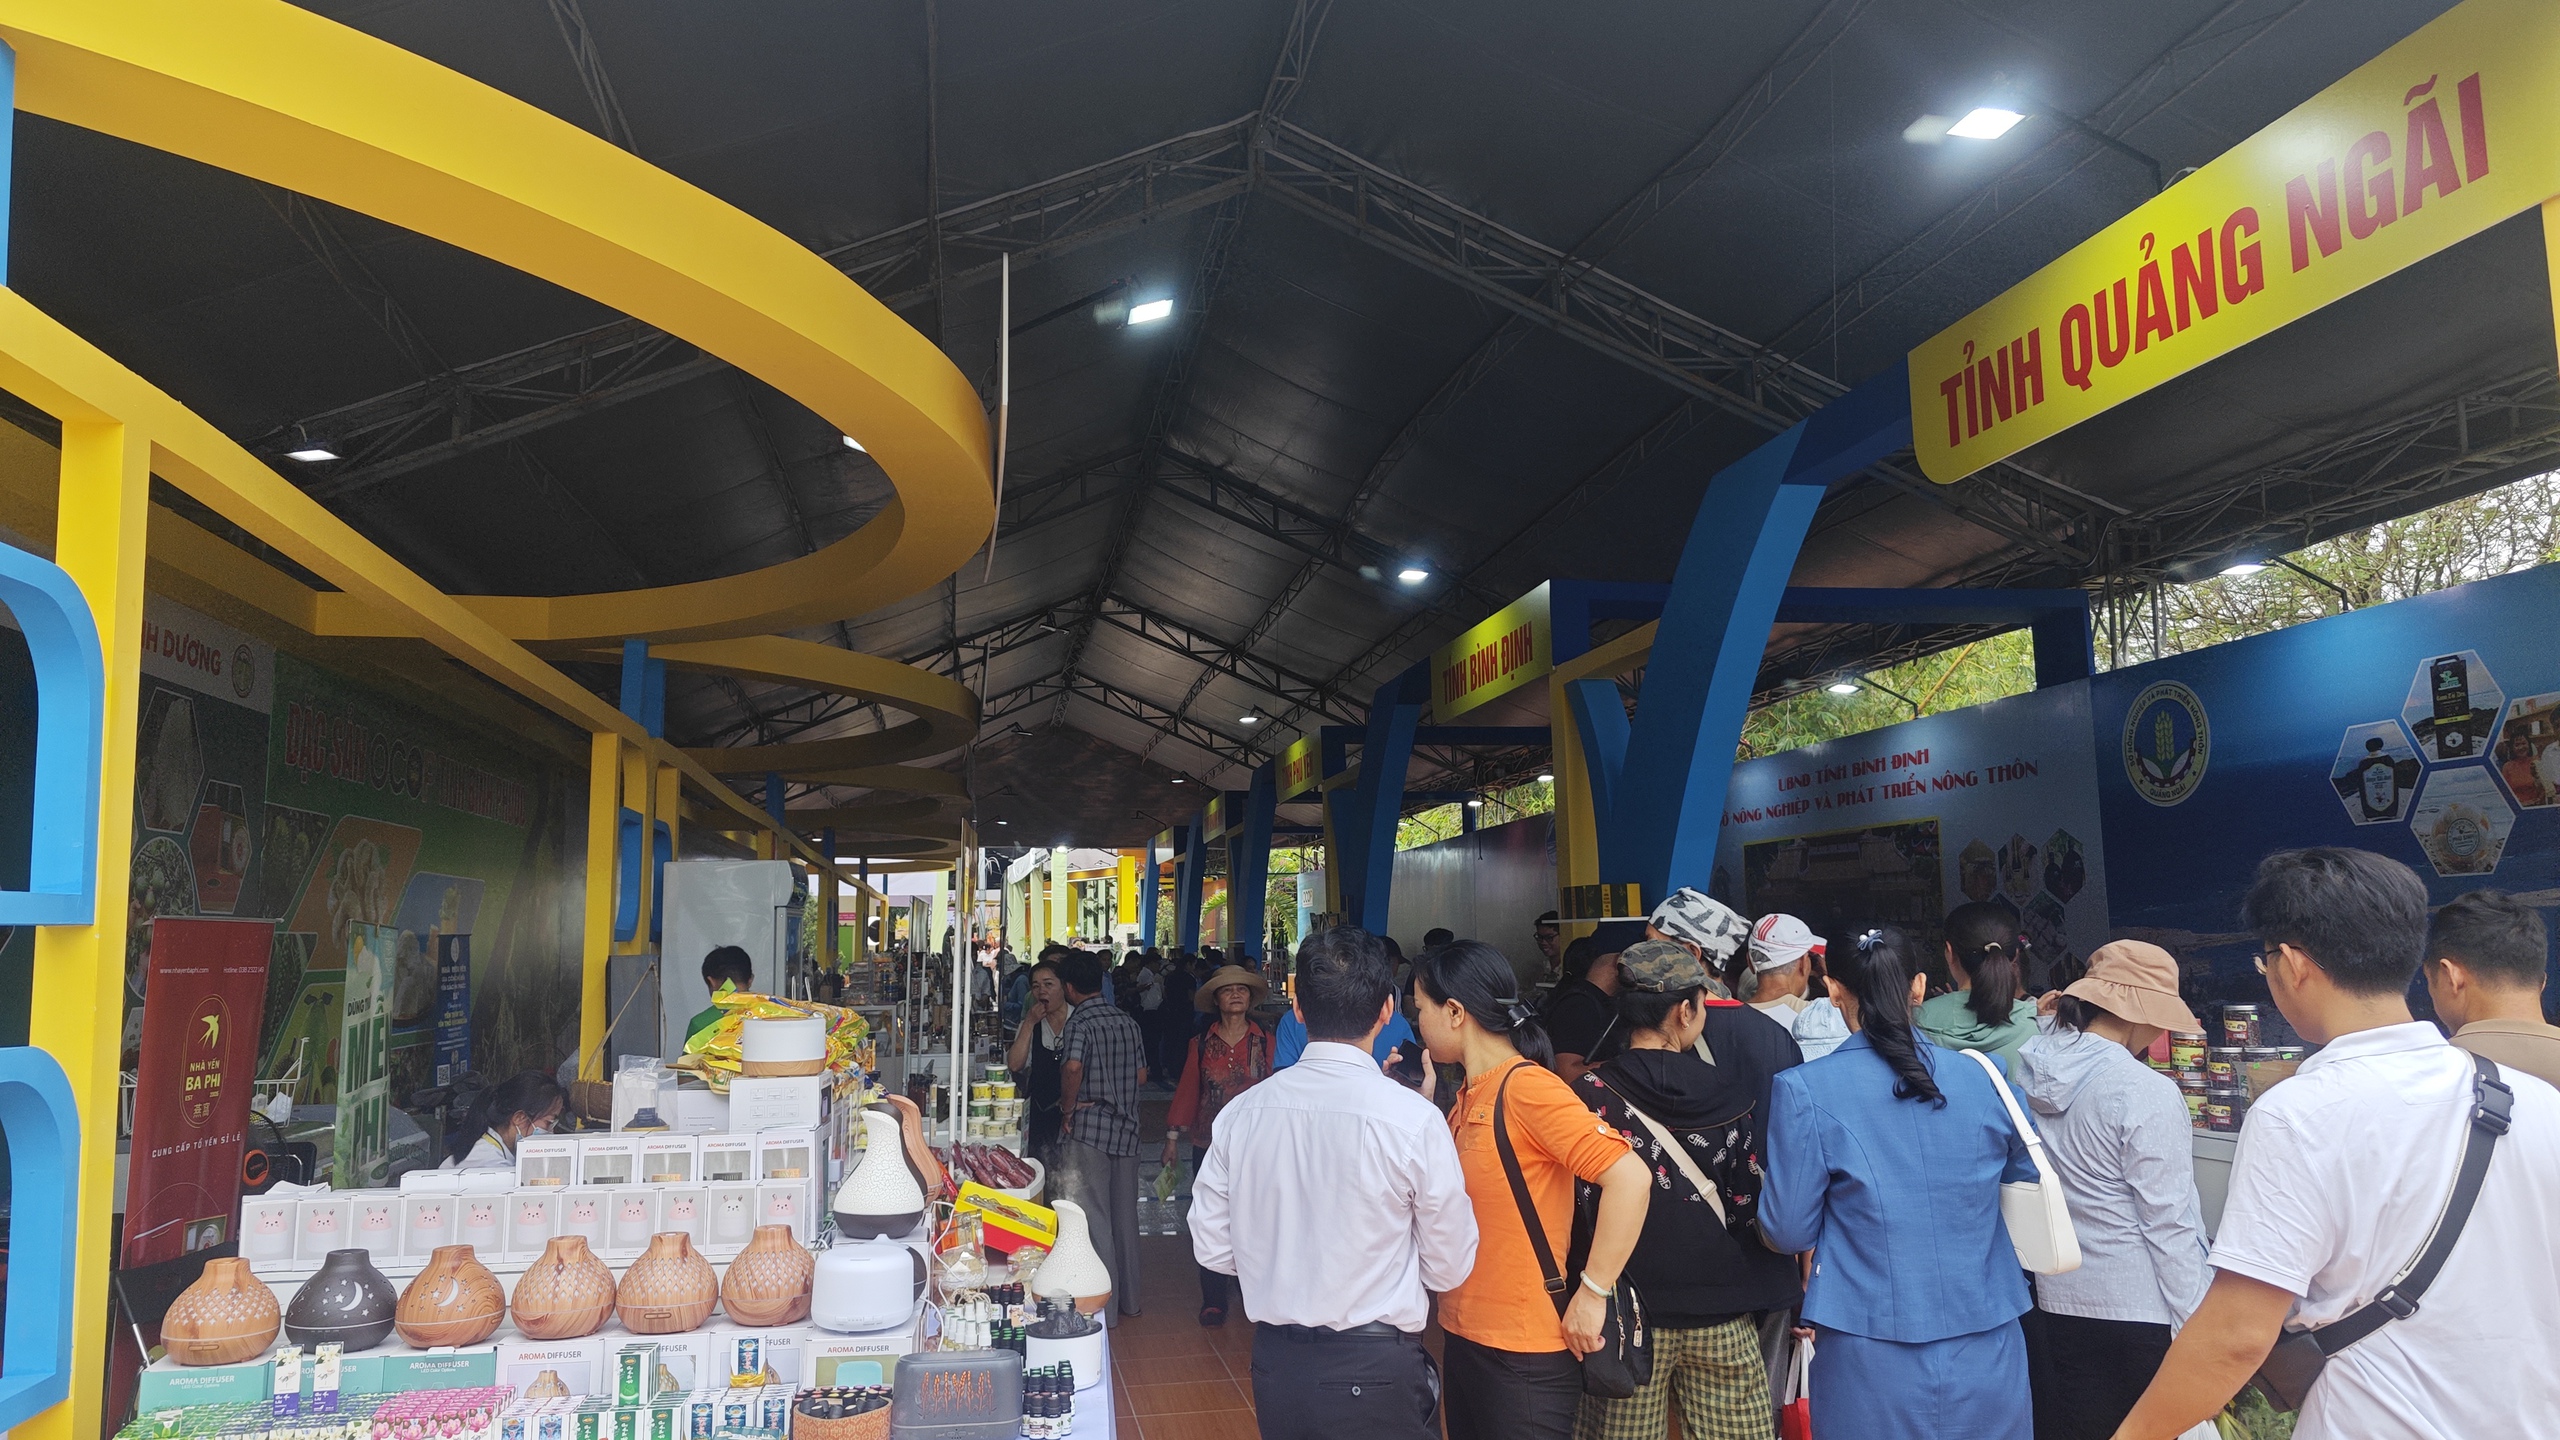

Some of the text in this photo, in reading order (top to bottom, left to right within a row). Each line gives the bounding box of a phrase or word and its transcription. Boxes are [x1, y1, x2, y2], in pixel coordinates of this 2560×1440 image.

[1940, 72, 2490, 448] TỈNH QUẢNG NGÃI
[163, 629, 221, 676] DƯƠNG
[1442, 620, 1533, 705] TỈNH BÌNH ĐỊNH
[1778, 773, 1811, 791] UBND
[1852, 757, 1886, 777] BÌNH
[1891, 748, 1929, 773] ĐỊNH
[1733, 807, 1762, 825] NÔNG
[1765, 797, 1809, 819] NGHIỆP
[1814, 791, 1832, 810] VÀ
[1837, 785, 1875, 807] PHÁT
[1882, 773, 1926, 800] TRIỂN
[1932, 770, 1978, 791] NÔNG
[1985, 758, 2039, 785] THÔN
[347, 998, 365, 1017] DÙNG
[189, 1057, 221, 1073] NHÀ YẾN
[185, 1073, 221, 1092] BA PHI
[152, 1146, 172, 1158] CUNG
[175, 1140, 191, 1153] CẤP
[204, 1136, 218, 1147] YẾN
[518, 1350, 582, 1360] AROMA DIFFUSER
[855, 1344, 890, 1353] DIFFUSER
[409, 1360, 470, 1370] AROMA DIFFUSER
[169, 1375, 235, 1386] AROMA DIFFUSER
